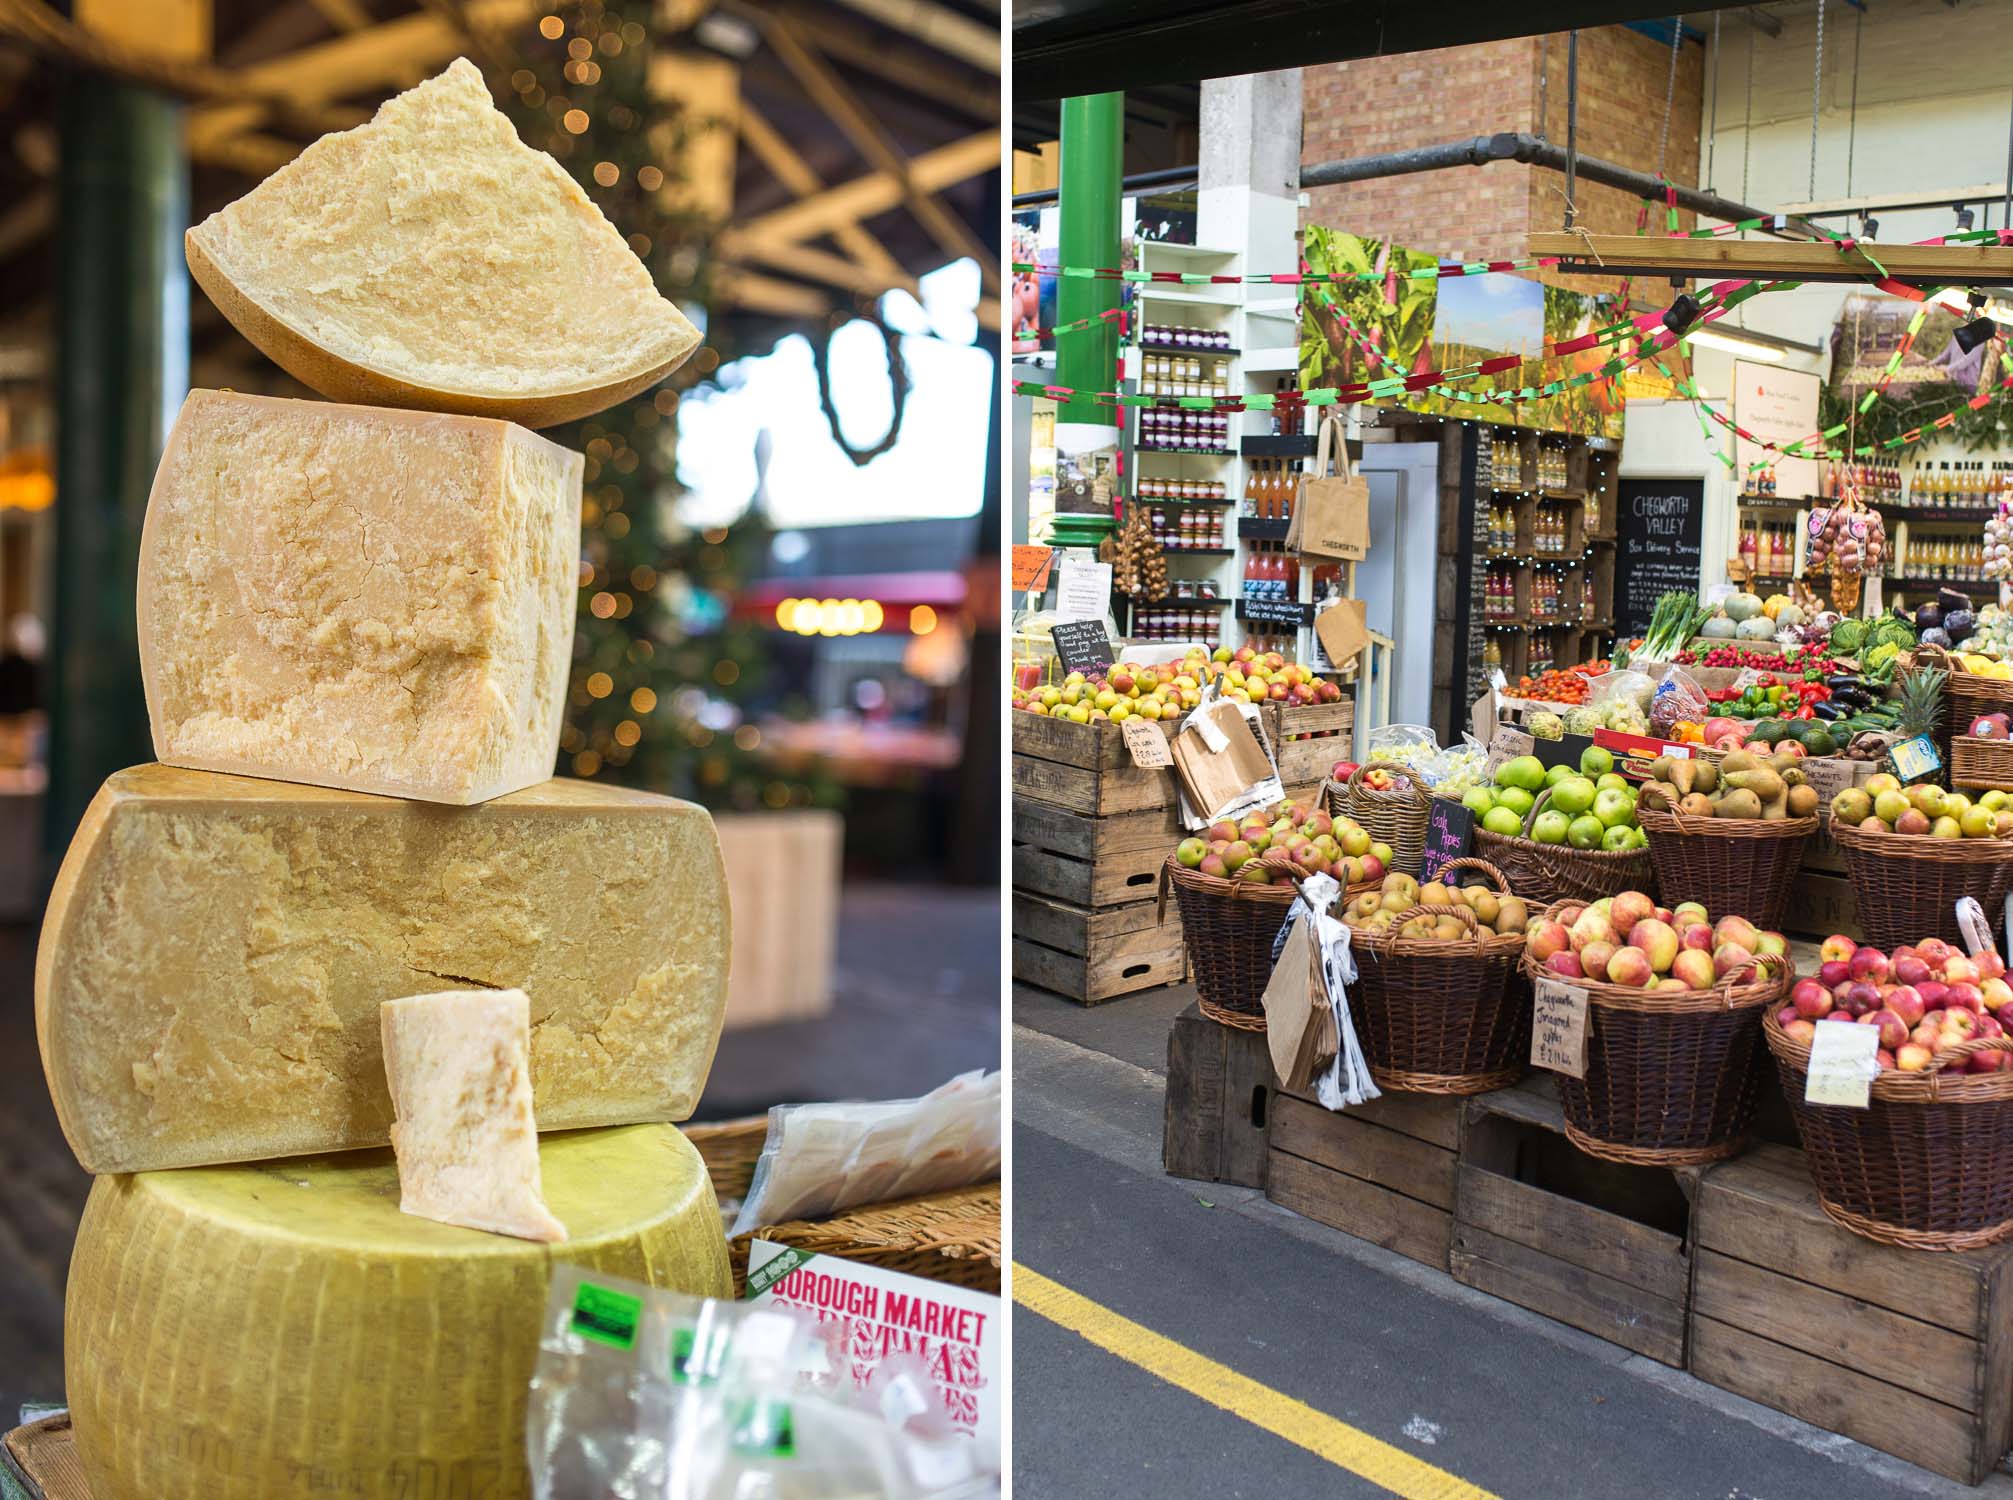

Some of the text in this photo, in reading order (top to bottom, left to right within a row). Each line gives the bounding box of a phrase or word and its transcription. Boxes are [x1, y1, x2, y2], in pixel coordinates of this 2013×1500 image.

[1633, 496, 1689, 517] CHEGWORTH
[1646, 517, 1685, 535] VALLEY
[1646, 540, 1671, 555] Delivery
[1055, 621, 1094, 635] Please help
[1432, 804, 1448, 829] Gala
[771, 1267, 987, 1347] BOROUGH MARKET
